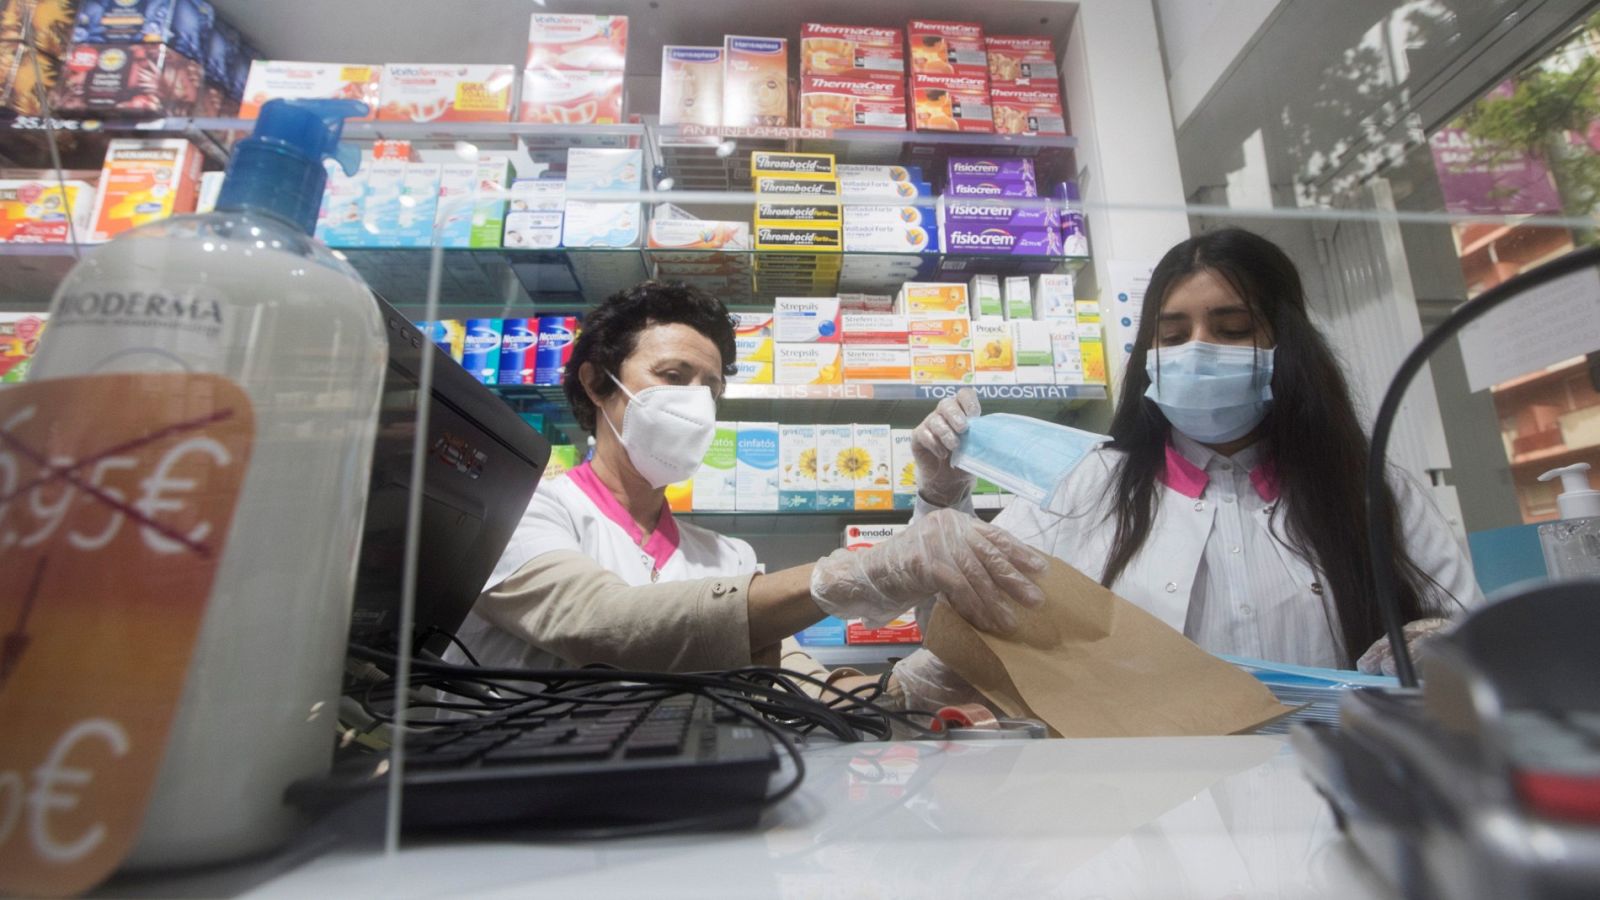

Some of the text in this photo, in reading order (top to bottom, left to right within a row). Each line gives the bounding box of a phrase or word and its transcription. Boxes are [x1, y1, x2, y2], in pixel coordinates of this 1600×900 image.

[807, 23, 896, 37] ThermaCare
[912, 21, 981, 33] ThermaCare
[985, 37, 1051, 47] ThermaCare
[811, 78, 895, 91] ThermaCare
[916, 74, 985, 86] ThermaCare
[991, 88, 1057, 99] ThermaCare
[756, 154, 818, 169] Thrombocid
[954, 162, 999, 173] fisiocrem
[761, 180, 822, 194] Thrombocid
[956, 184, 1001, 194] fisiocrem
[760, 204, 815, 217] Thrombocid
[950, 204, 1012, 217] fisiocrem
[759, 229, 814, 242] Thrombocid
[951, 231, 1014, 245] fisiocrem
[780, 302, 819, 311] Strepsils
[780, 348, 819, 358] Strepsils
[828, 384, 868, 398] MEL
[920, 386, 1069, 398] TOS MUCOSITAT
[738, 437, 775, 449] cinfatós
